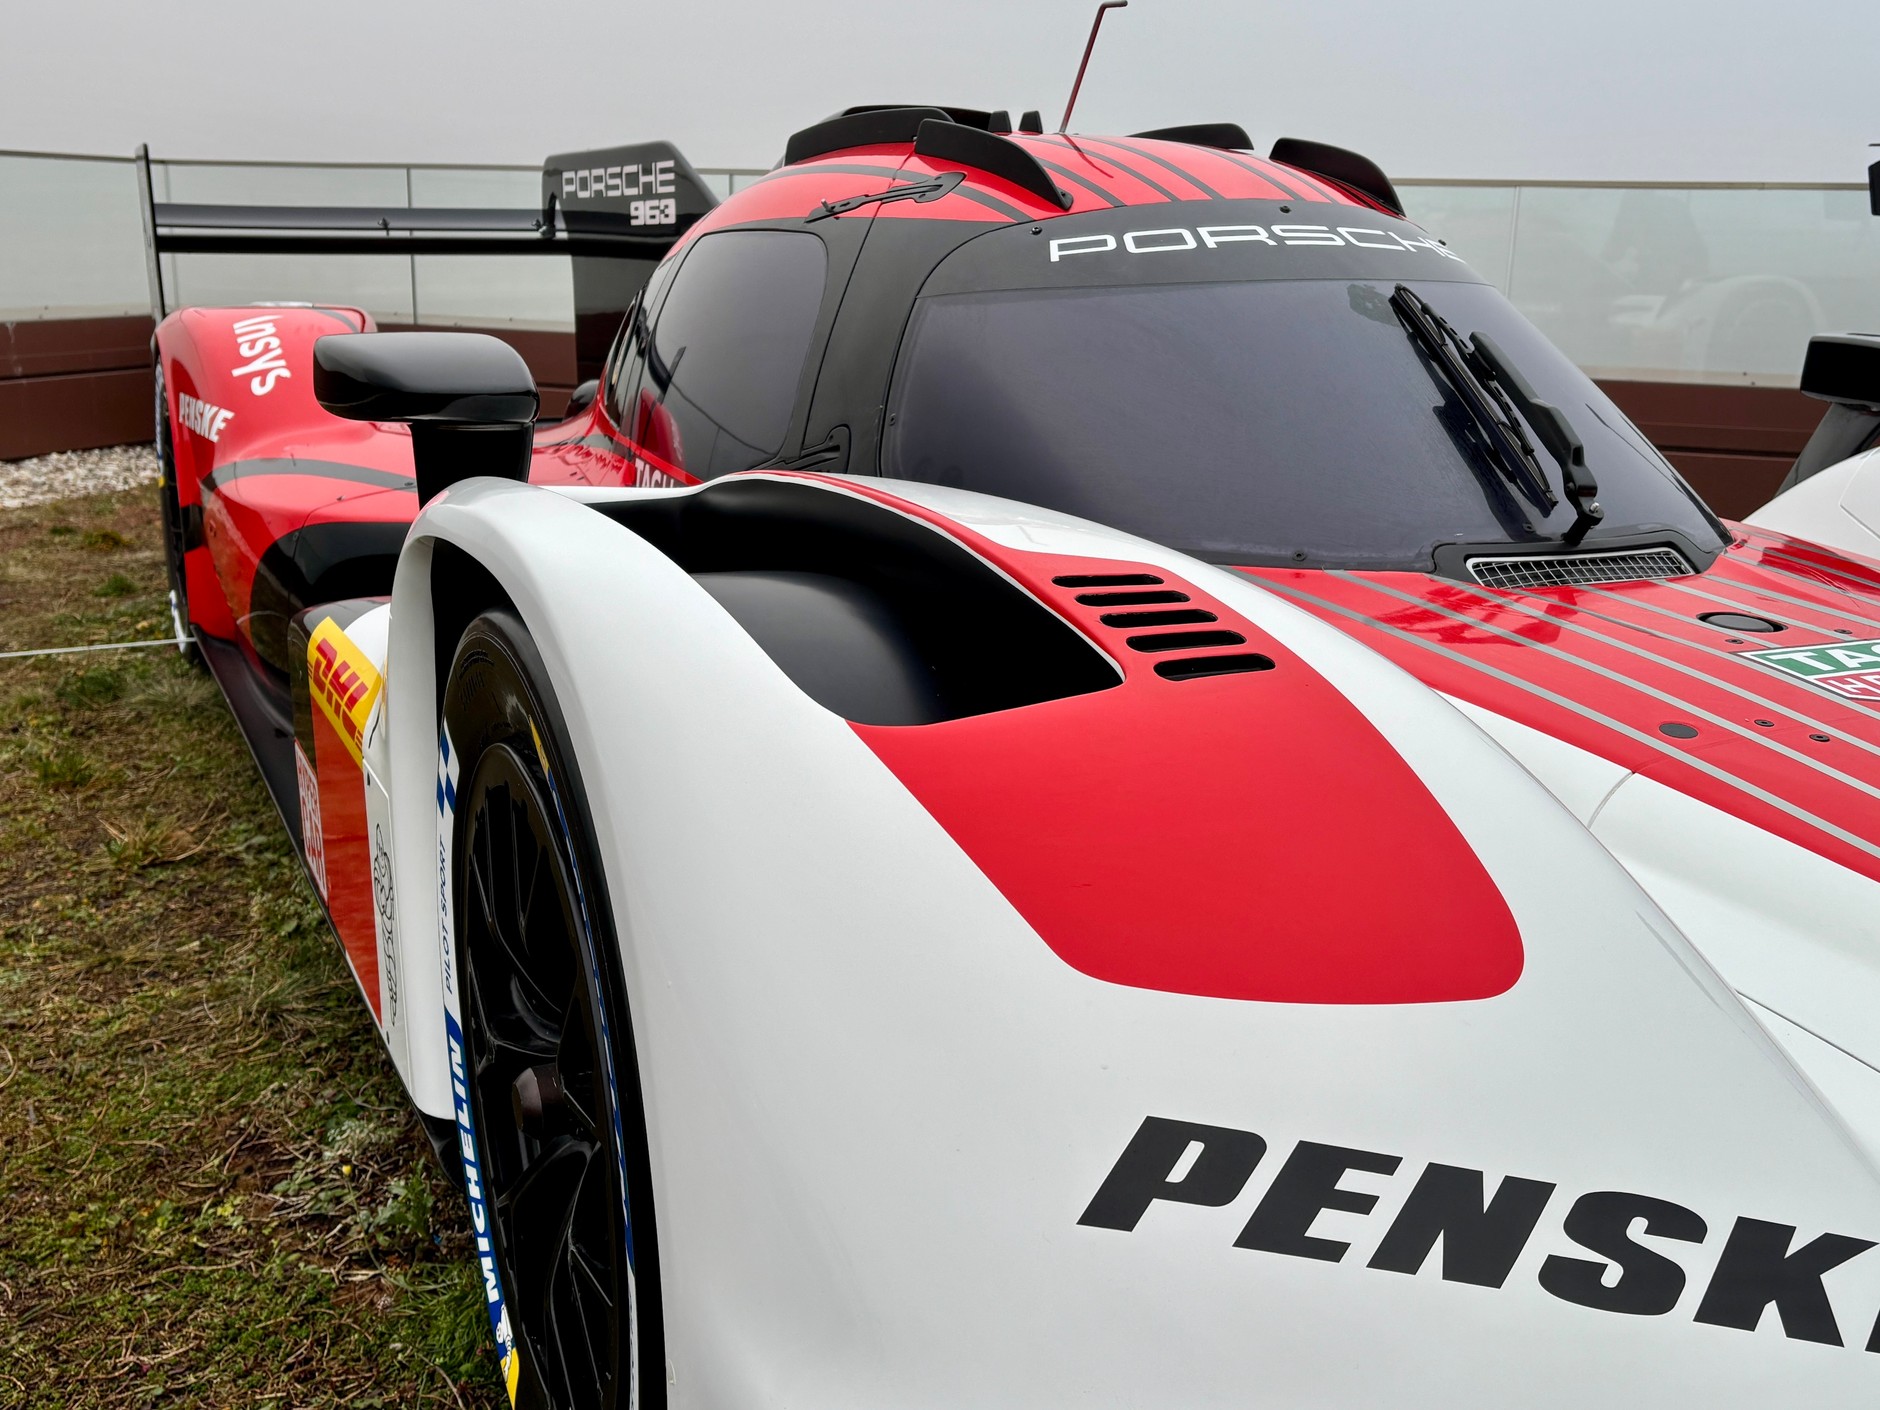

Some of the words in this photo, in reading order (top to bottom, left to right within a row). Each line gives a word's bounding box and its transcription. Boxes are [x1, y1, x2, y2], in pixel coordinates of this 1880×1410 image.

[562, 160, 676, 199] PORSCHE
[630, 198, 676, 226] 963
[1049, 224, 1466, 264] PORSCHE
[231, 315, 291, 396] Insys
[179, 392, 236, 443] PENSKE
[312, 638, 369, 743] DHL
[1765, 644, 1880, 671] TA
[439, 834, 449, 917] SPORT
[441, 922, 453, 994] PILOT
[448, 1033, 501, 1304] MICHELIN
[1076, 1115, 1880, 1353] PENSK
